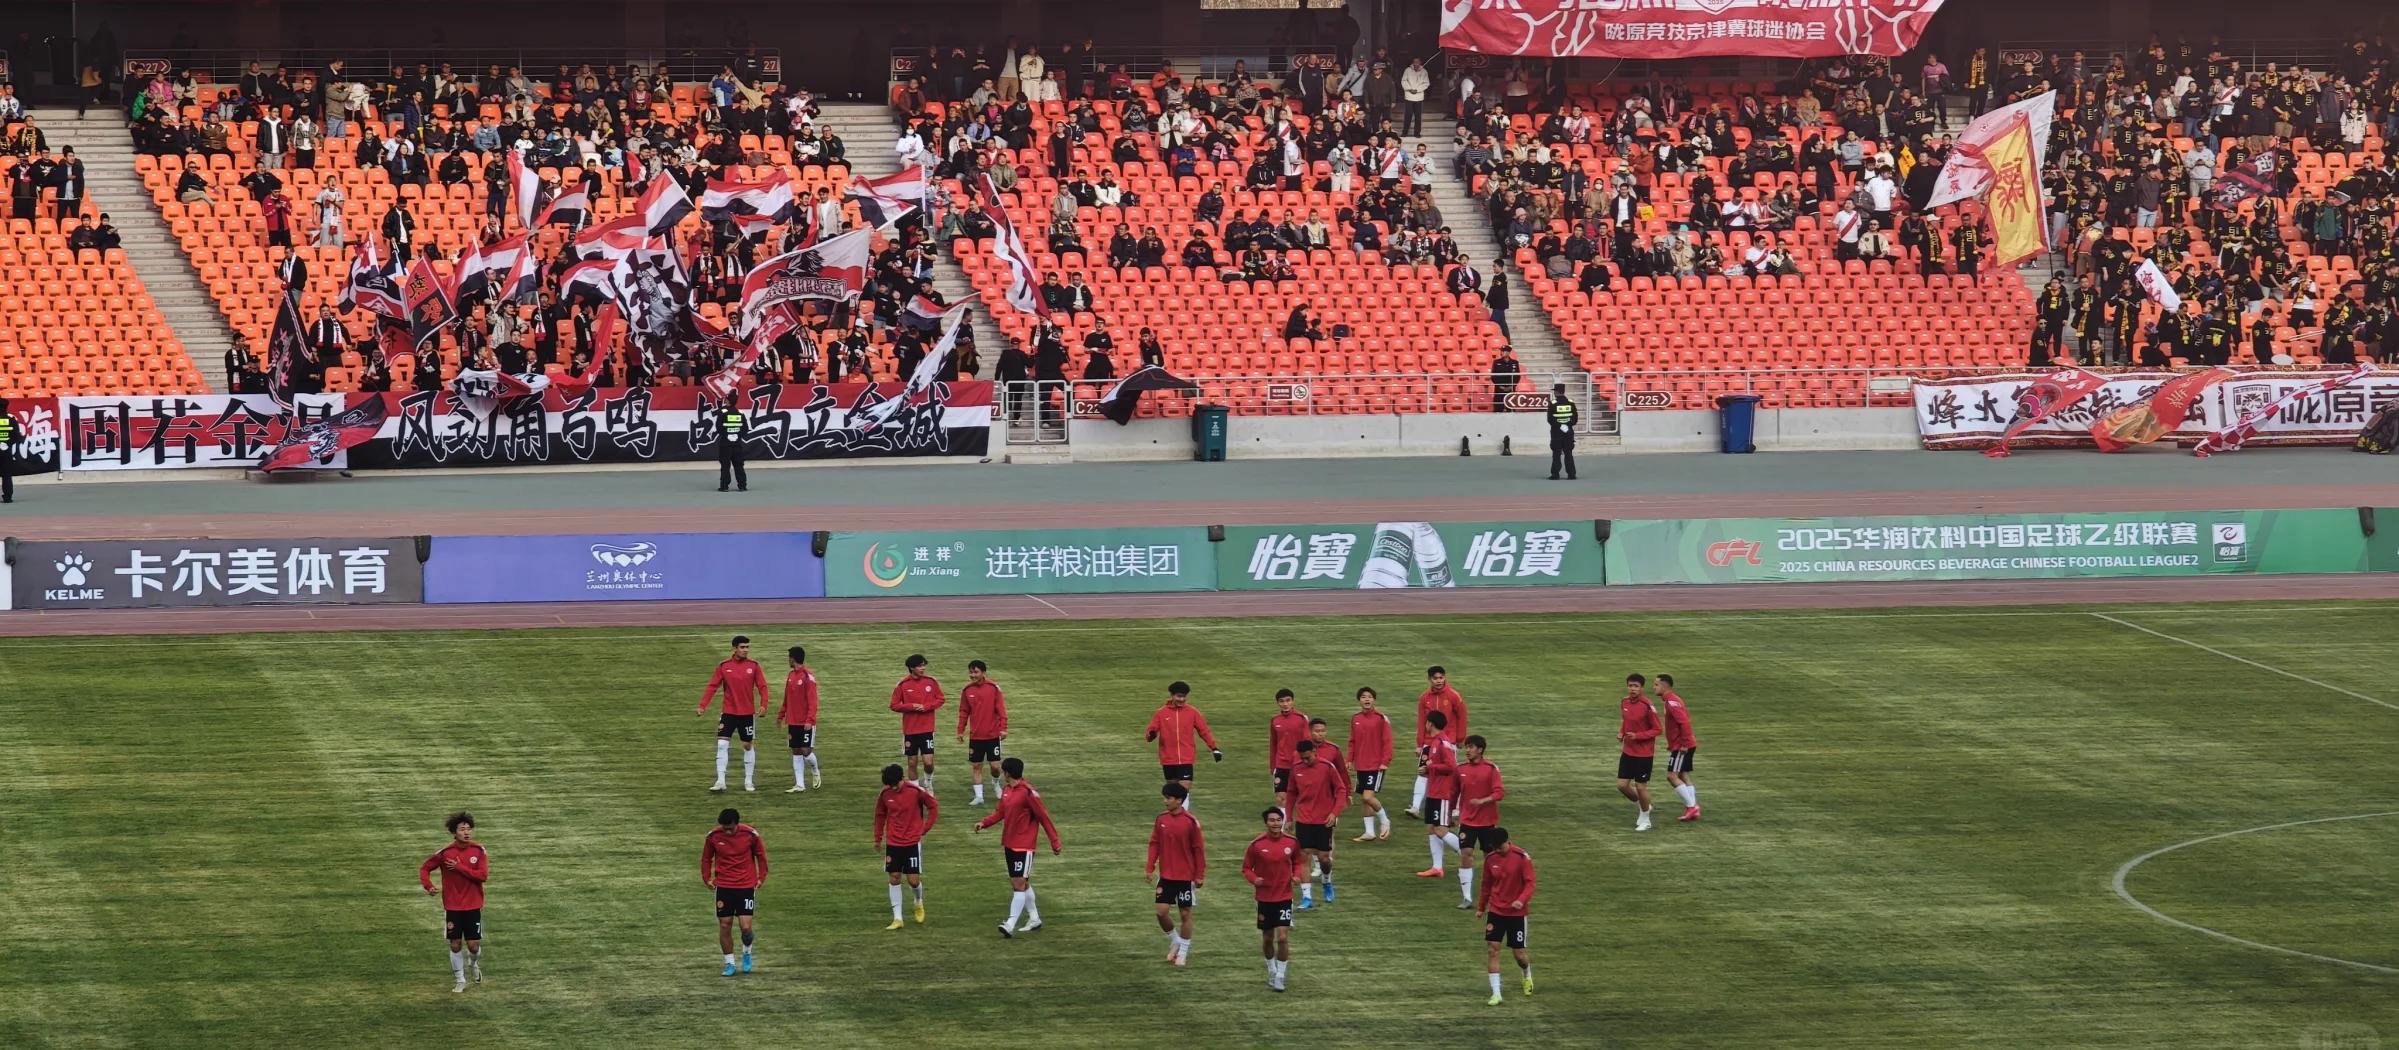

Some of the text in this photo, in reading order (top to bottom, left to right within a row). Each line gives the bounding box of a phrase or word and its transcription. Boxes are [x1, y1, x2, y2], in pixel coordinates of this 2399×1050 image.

[1605, 19, 1826, 41] 陇原竞技京津冀球迷协会
[1304, 57, 1333, 67] C26
[1517, 395, 1549, 408] C226
[1627, 393, 1660, 406] C225
[391, 386, 658, 462] 风劲角弓鸣
[1777, 522, 2198, 551] 2025华润饮料中国足球乙级联赛
[913, 546, 952, 562] 进祥
[1247, 532, 1358, 581] 怡寶
[1463, 529, 1573, 577] 怡寶
[985, 545, 1179, 578] 进祥粮油集团
[1780, 554, 2199, 573] 2025 CHINA RESOURCES BEVERAGE CHINESE FOOTBALL LEAGUE2
[114, 546, 390, 598] 卡尔美体育
[586, 569, 663, 583] 兰州奥体中心
[910, 566, 960, 577] Jin Xiang
[45, 588, 105, 601] KELME
[745, 726, 753, 736] 15
[803, 733, 810, 743] 5
[994, 746, 1000, 756] 6
[1366, 775, 1374, 785] 3
[909, 857, 918, 868] 11
[1014, 861, 1023, 872] 19
[1178, 890, 1191, 901] 46
[744, 898, 754, 910] 10
[1279, 909, 1291, 920] 26
[1516, 930, 1523, 942] 8
